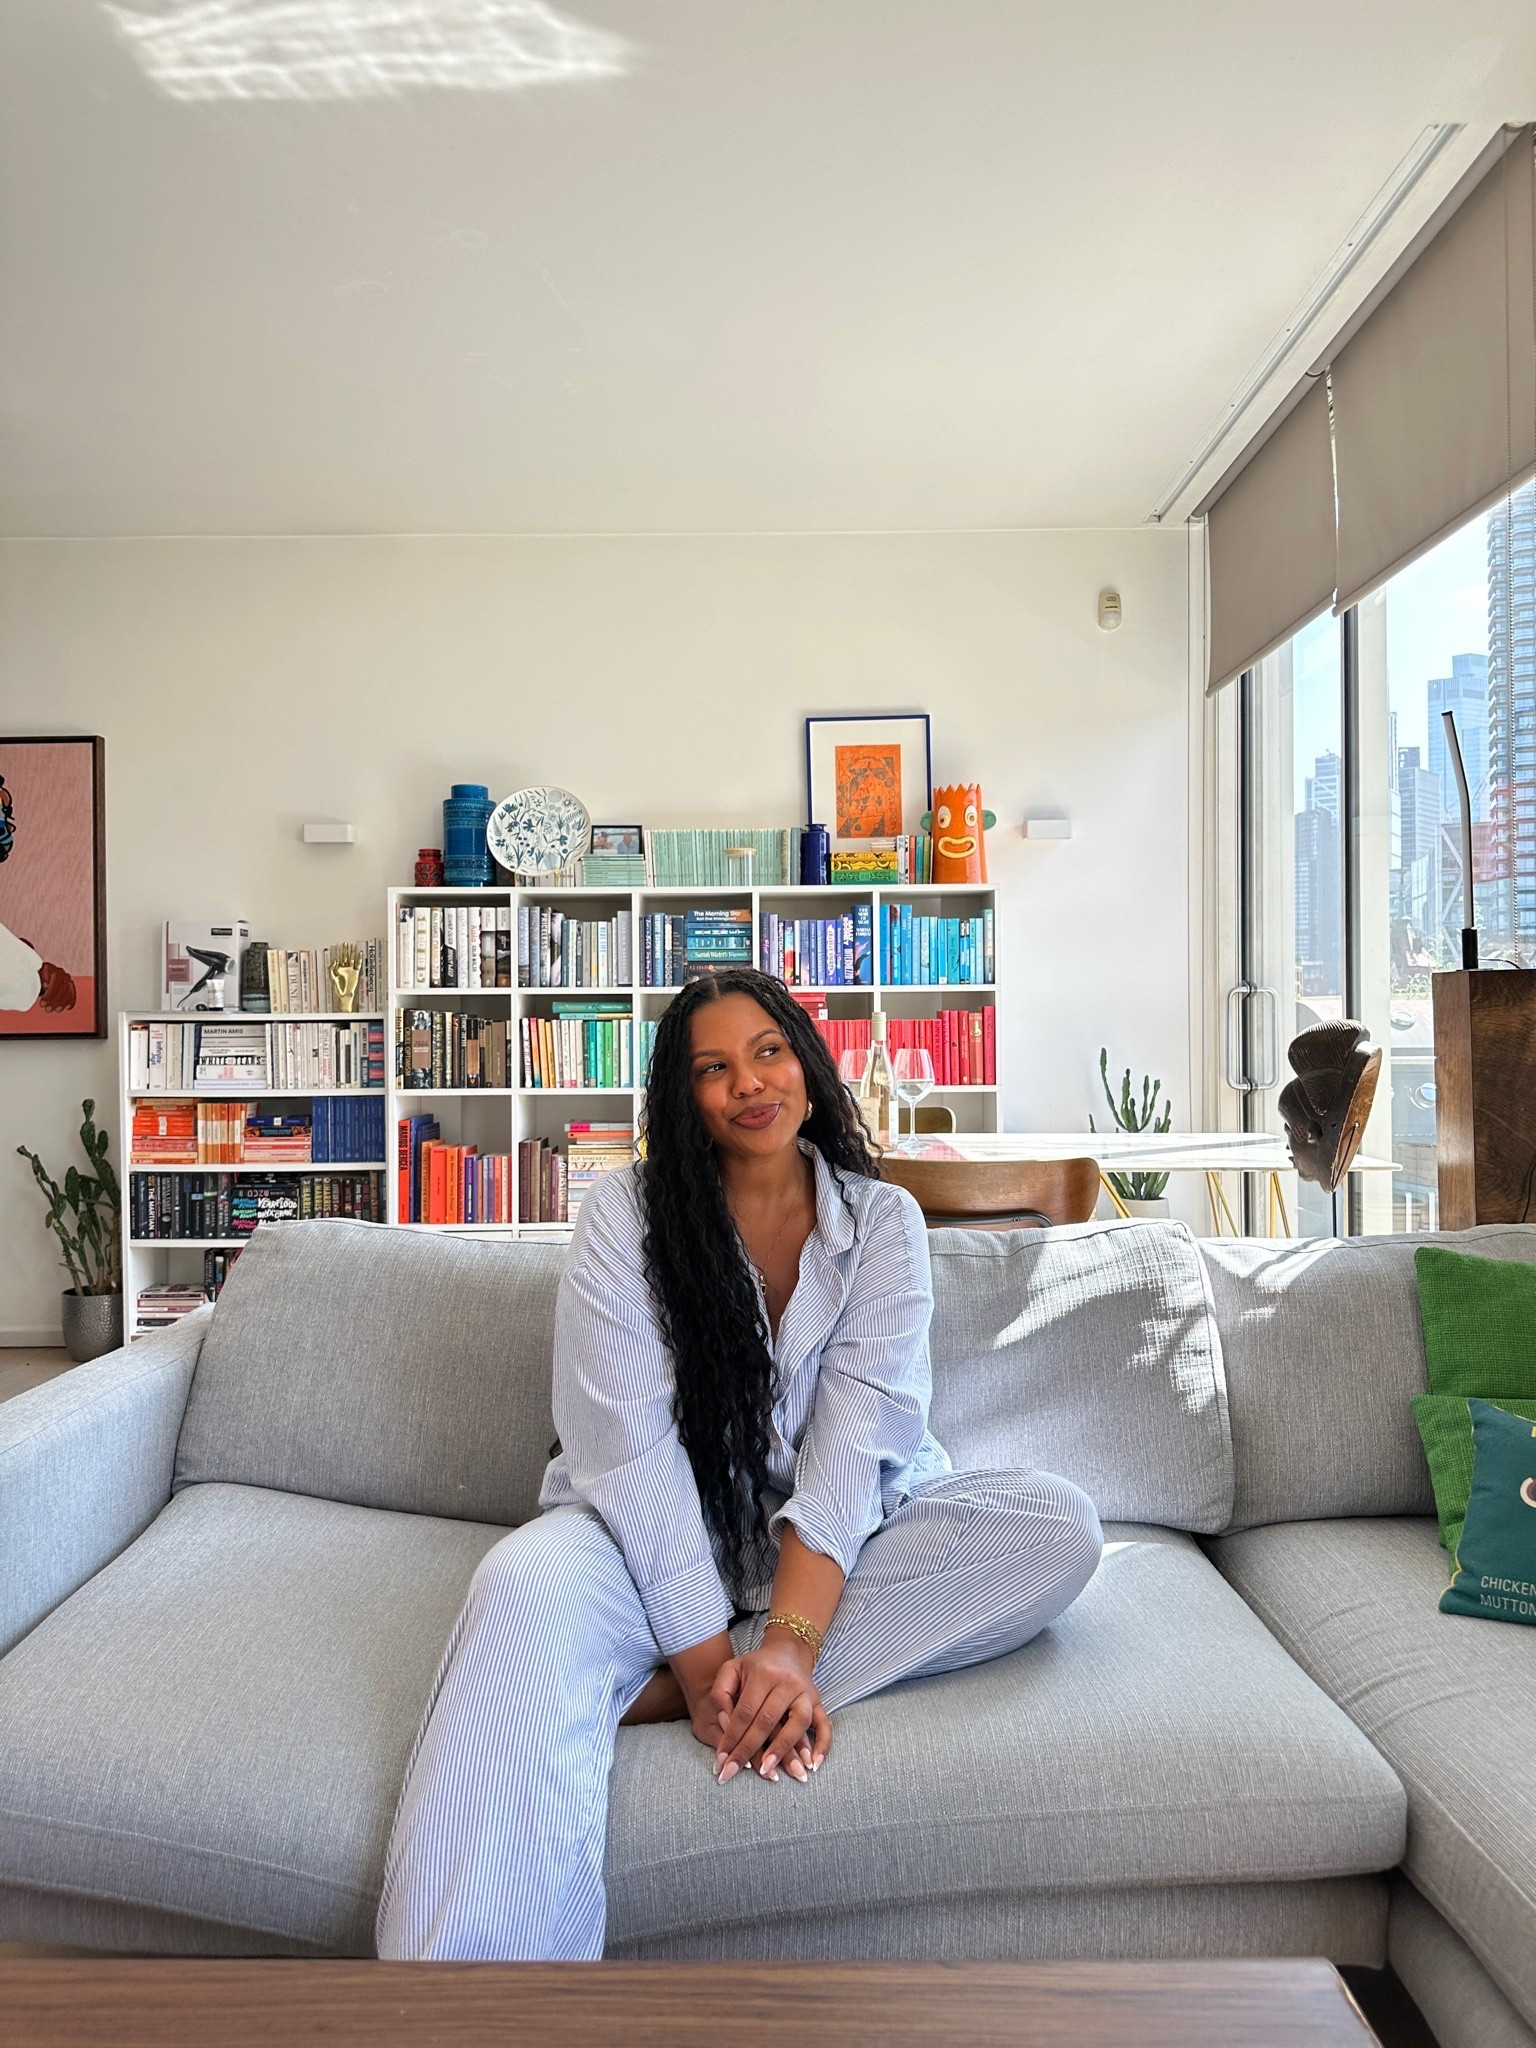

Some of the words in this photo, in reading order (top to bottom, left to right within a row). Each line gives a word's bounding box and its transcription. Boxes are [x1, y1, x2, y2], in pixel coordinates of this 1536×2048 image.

[290, 974, 298, 1001] DUNE
[399, 1126, 407, 1148] MARIUS
[399, 1150, 407, 1171] BERCEA
[558, 1162, 566, 1205] OVERSTORY
[206, 1204, 210, 1212] OF
[1480, 1576, 1536, 1597] CHICKEN
[1480, 1594, 1536, 1617] MUTTON
